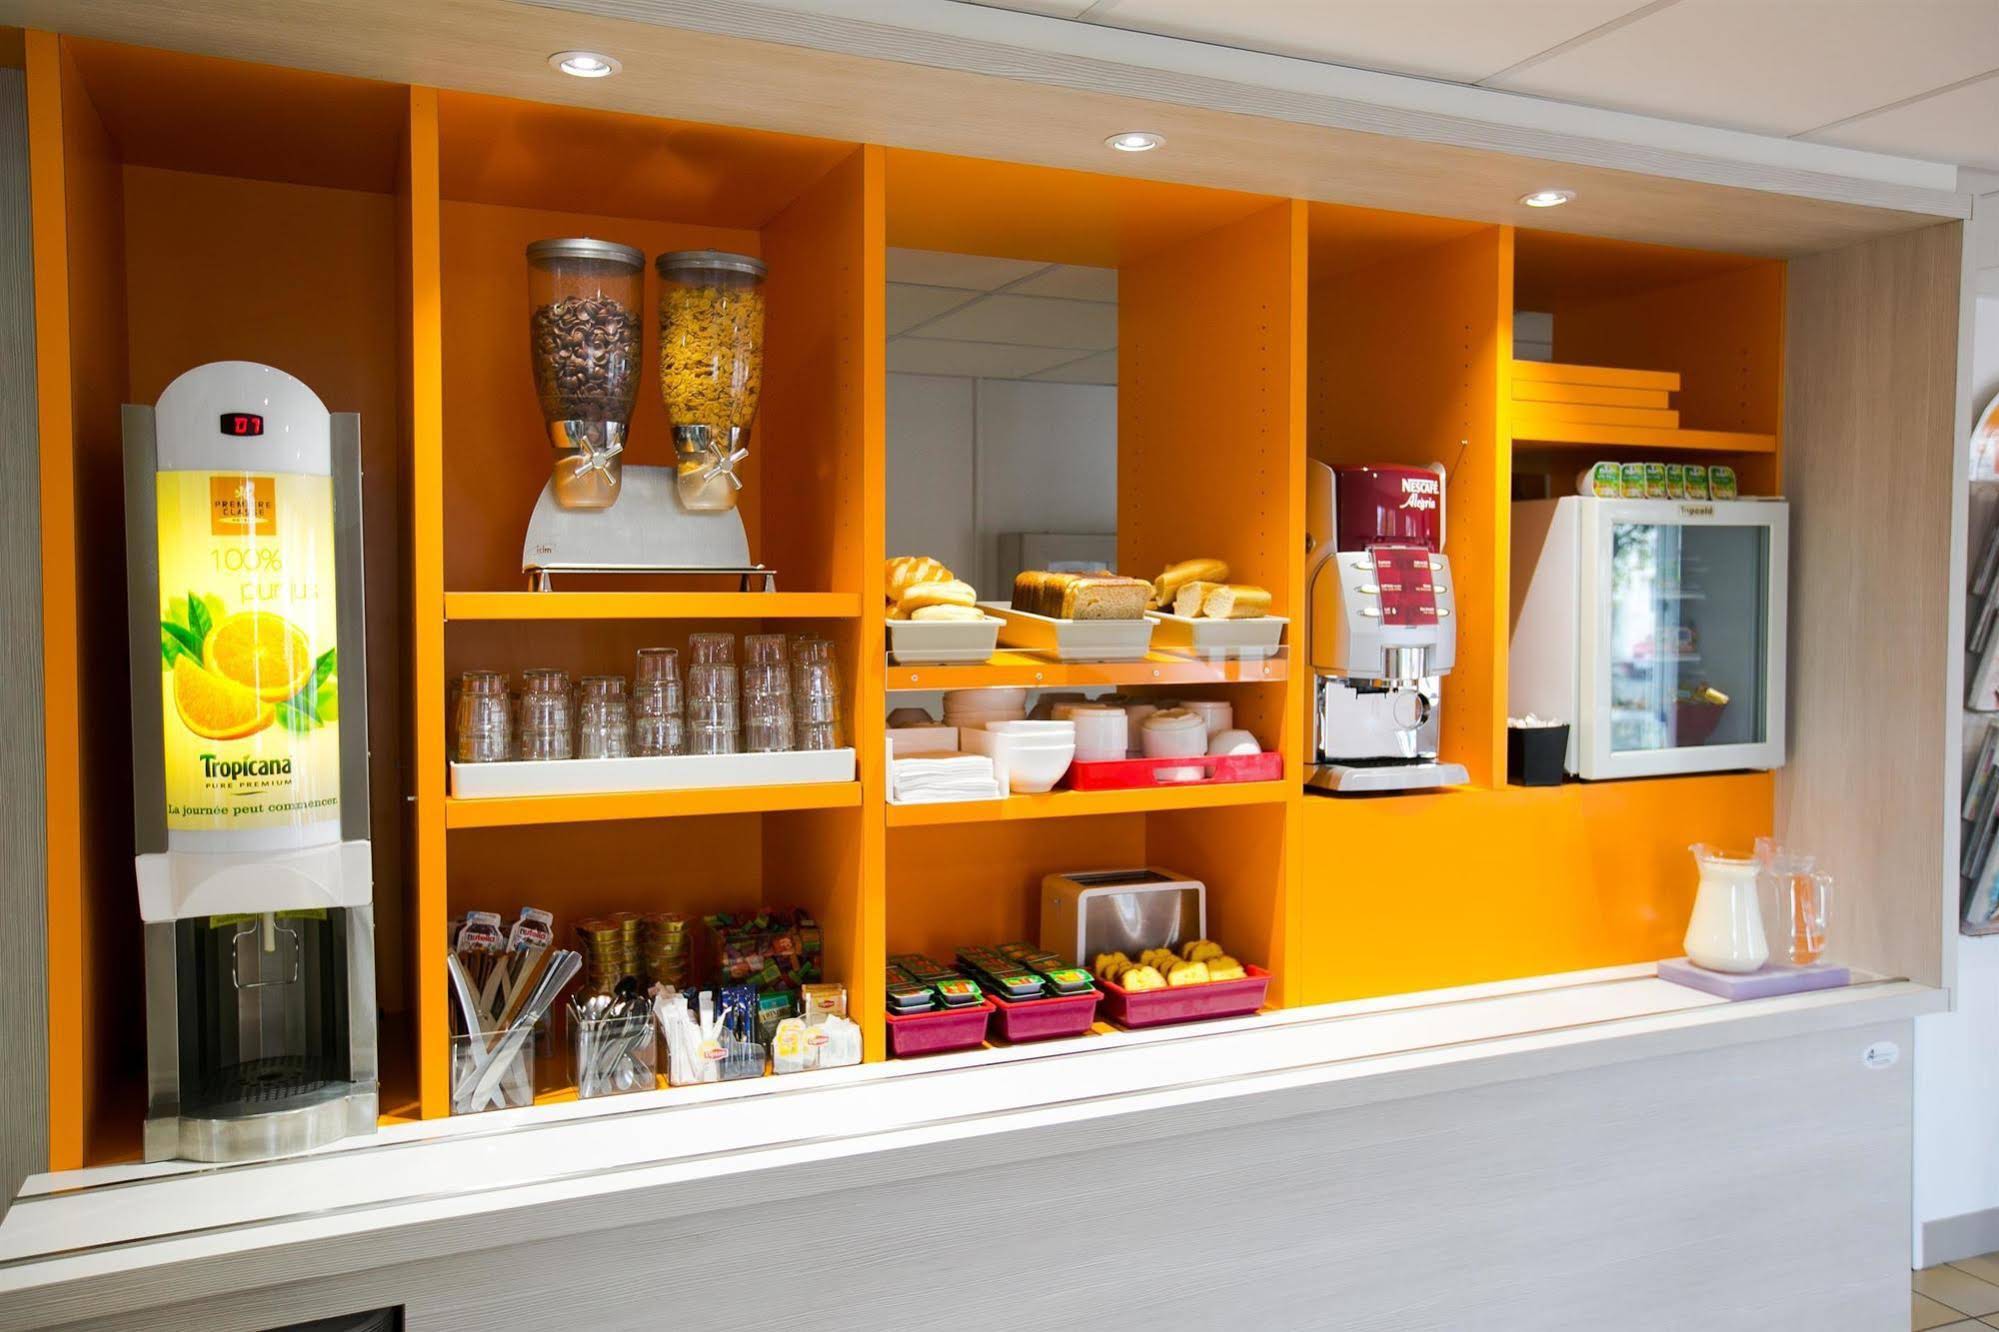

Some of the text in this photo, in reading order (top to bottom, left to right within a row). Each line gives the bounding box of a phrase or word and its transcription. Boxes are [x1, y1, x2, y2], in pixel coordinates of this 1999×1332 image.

[214, 500, 270, 508] PREMIRE
[210, 547, 282, 571] 100%
[199, 753, 293, 781] Tropicana
[239, 779, 292, 788] PREMIUM
[168, 797, 338, 817] La journée peut commencer
